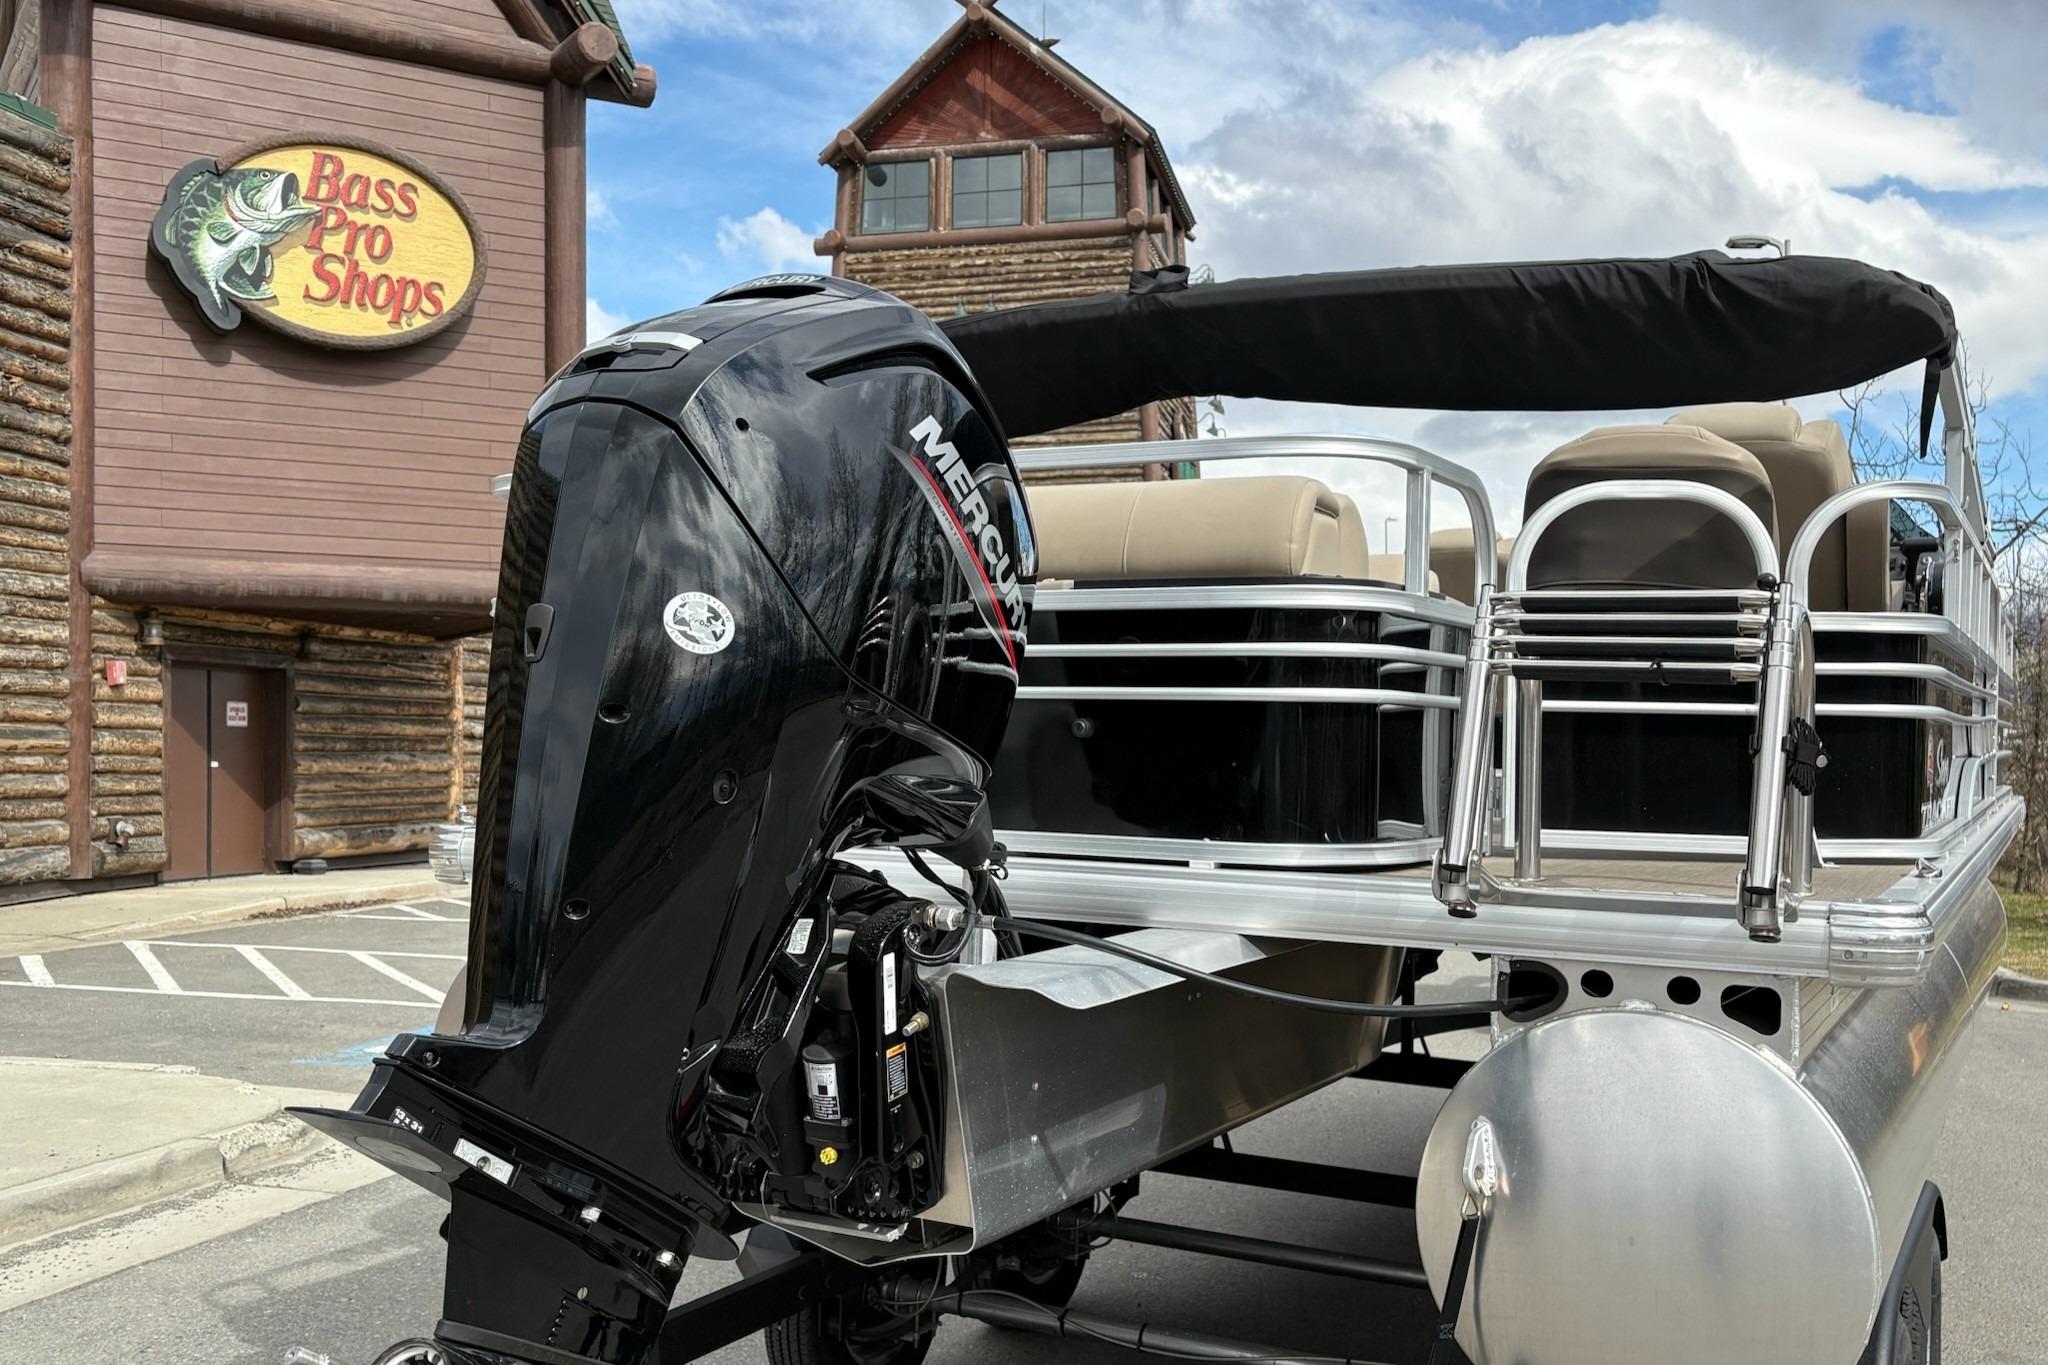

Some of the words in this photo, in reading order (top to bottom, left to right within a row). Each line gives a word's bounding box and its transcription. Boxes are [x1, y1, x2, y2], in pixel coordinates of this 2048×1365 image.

[301, 151, 420, 218] Bass
[303, 205, 393, 260] Pro
[303, 253, 446, 328] Shops
